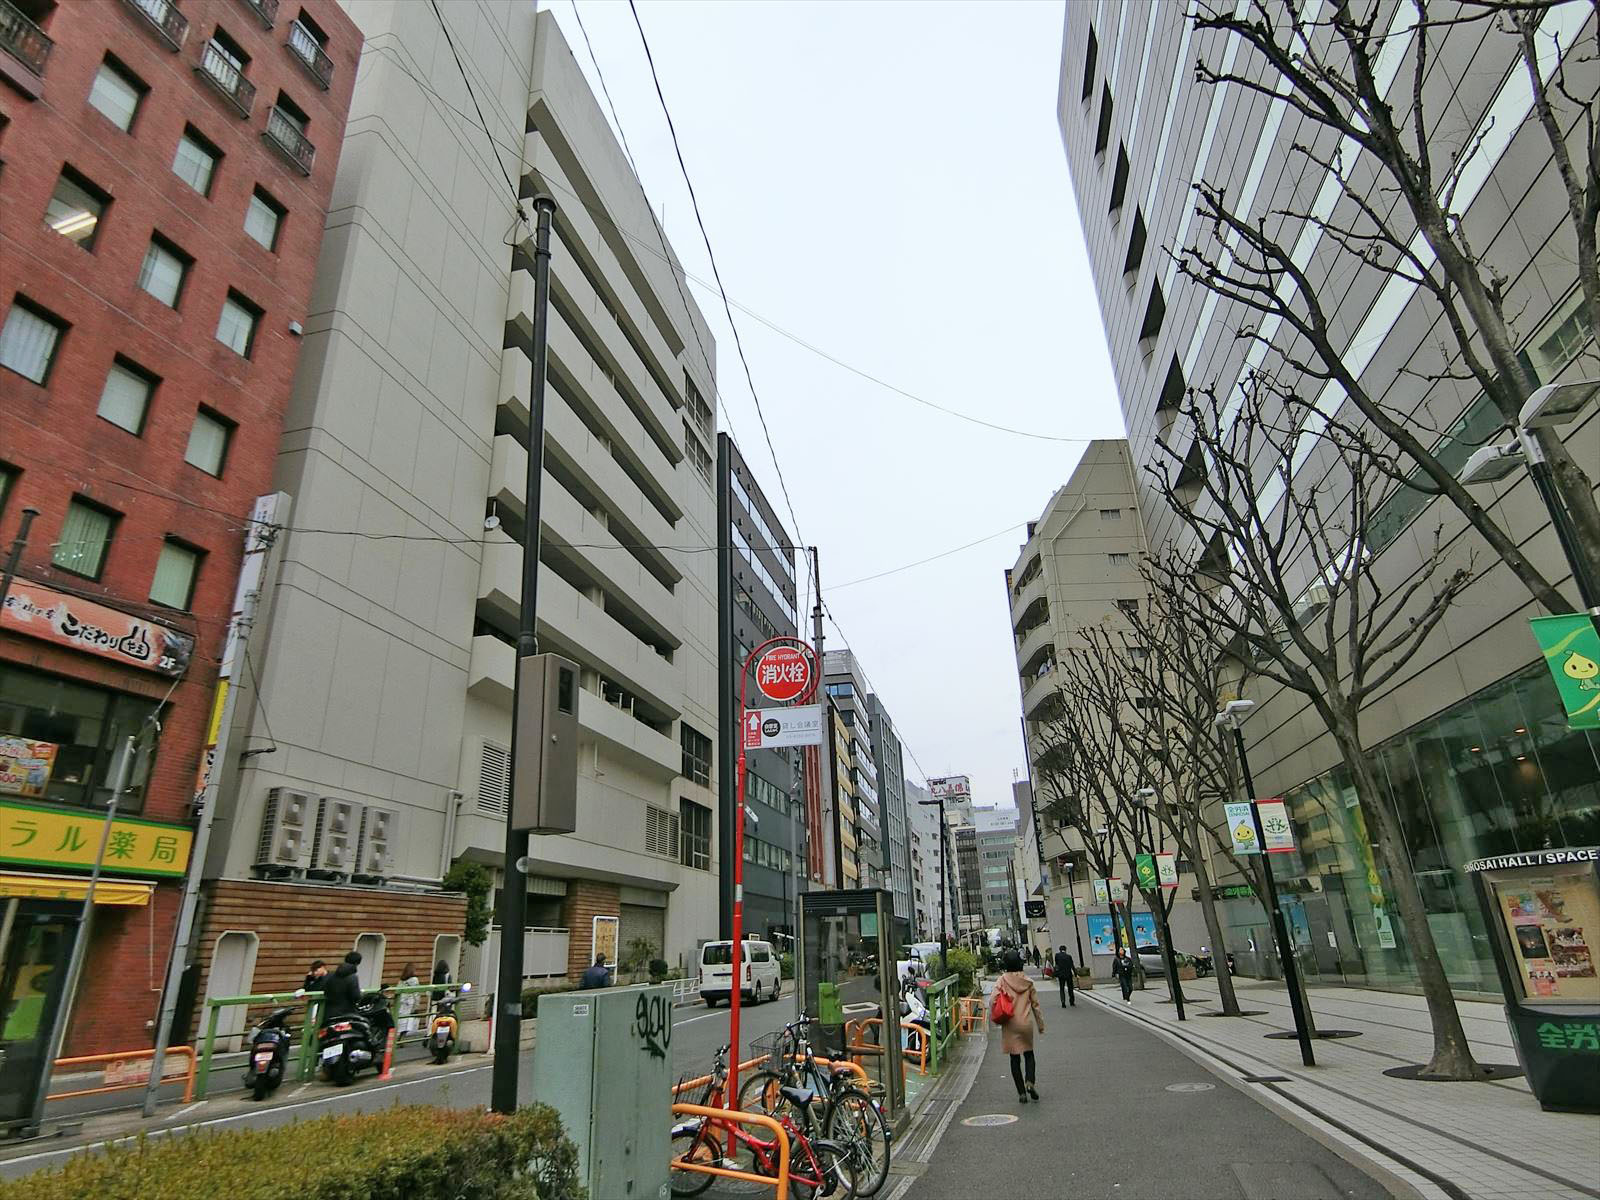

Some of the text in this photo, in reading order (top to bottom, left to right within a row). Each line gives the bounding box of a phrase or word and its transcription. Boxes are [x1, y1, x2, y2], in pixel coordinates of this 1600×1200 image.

[159, 655, 176, 670] 2F
[761, 662, 805, 684] 消火栓
[10, 820, 178, 864] ラル薬局
[1498, 855, 1536, 868] HALL
[1546, 849, 1599, 864] SPACE
[1537, 1023, 1600, 1049] 全労
